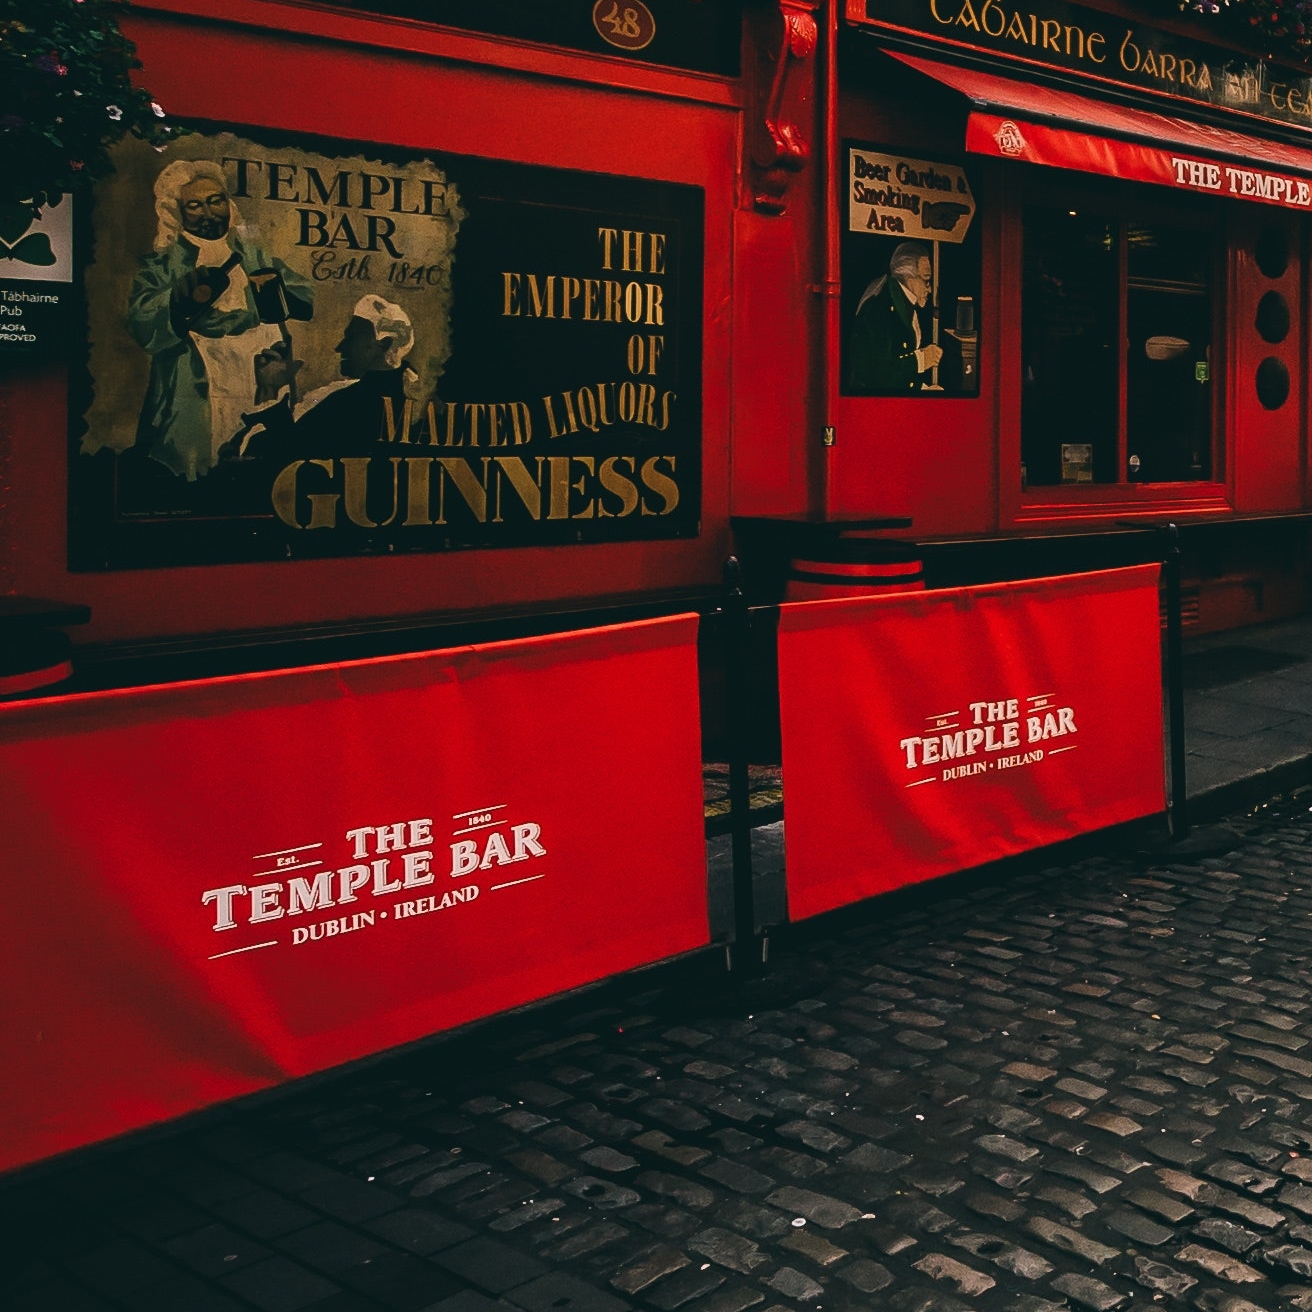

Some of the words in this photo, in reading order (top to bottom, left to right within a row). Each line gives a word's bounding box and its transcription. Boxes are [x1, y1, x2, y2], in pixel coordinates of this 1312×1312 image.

[600, 0, 640, 39] 48
[222, 156, 450, 217] TEMPLE
[854, 155, 891, 183] Beer
[896, 162, 952, 192] Garden
[1172, 157, 1221, 190] THE
[1225, 167, 1312, 206] TEMPLE
[854, 180, 921, 215] Smoking
[295, 208, 404, 259] BAR
[866, 208, 905, 233] Area
[598, 227, 666, 275] THE
[388, 261, 443, 286] 1840
[1, 305, 23, 315] Pub
[501, 272, 664, 326] EMPEROR
[627, 334, 664, 375] OF
[376, 395, 532, 447] MALTED
[542, 381, 677, 439] LIQUORS
[271, 456, 680, 529] GUINNESS
[969, 699, 1019, 725] THE
[900, 722, 1020, 769] TEMPLE
[1027, 707, 1077, 744] BAR
[943, 761, 987, 782] DUBLIN
[997, 749, 1044, 770] IRELAND
[346, 818, 434, 860] THE
[468, 813, 492, 826] 1840
[202, 850, 435, 932] TEMPLE
[449, 821, 547, 878] BAR
[276, 855, 300, 867] Est.
[292, 910, 375, 946] DUBLIN
[394, 885, 480, 920] IRELAND
